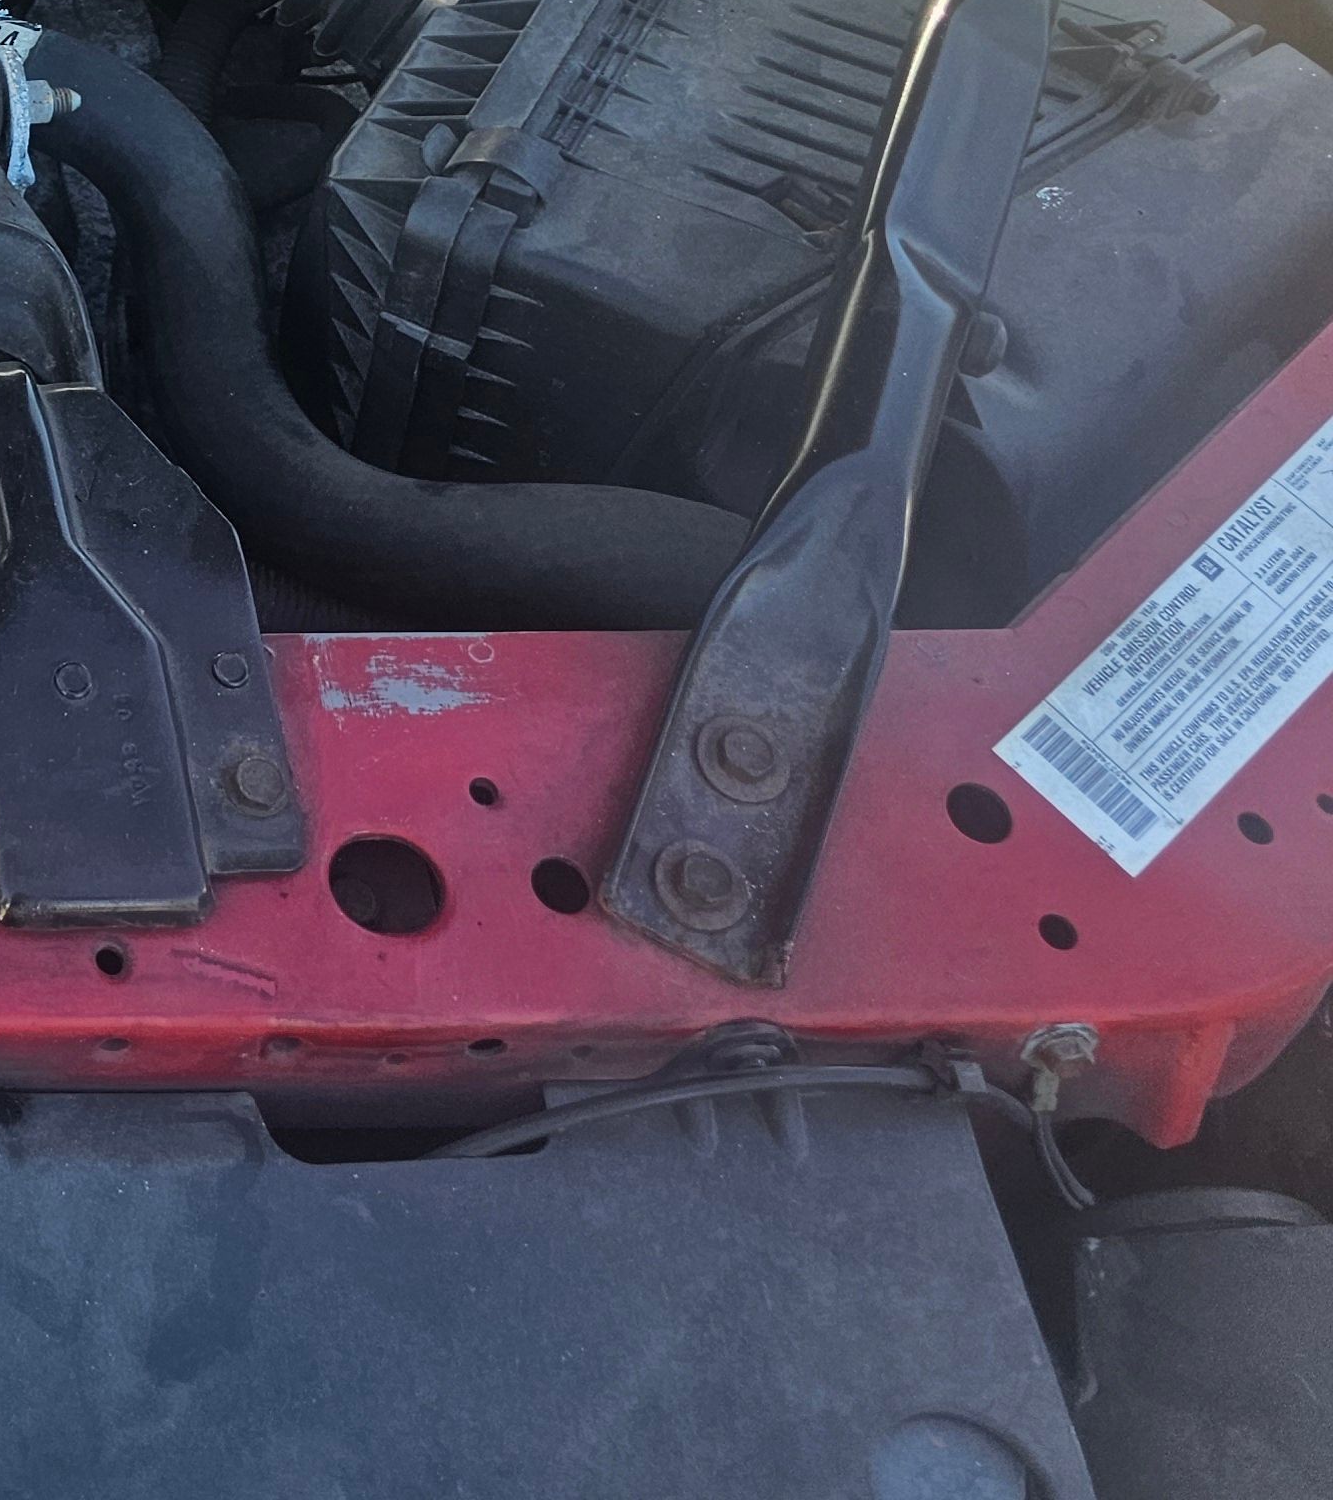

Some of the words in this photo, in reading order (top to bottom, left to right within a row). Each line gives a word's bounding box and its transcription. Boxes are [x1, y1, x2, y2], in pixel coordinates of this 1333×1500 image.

[1218, 495, 1277, 554] CATALYST
[1081, 656, 1124, 699] VEHICLE
[1117, 614, 1166, 663] EMISSION
[1156, 578, 1201, 624] CONTROL
[1124, 616, 1187, 679] INFORMATION
[1137, 760, 1160, 782] THIS
[1153, 733, 1186, 766] VEHICLE
[1179, 698, 1221, 740] CONFORMS
[1213, 689, 1229, 705] TO
[1236, 662, 1255, 682] EPA
[1248, 622, 1295, 669] REGULATIONS
[1288, 588, 1329, 628] APPLICABLE
